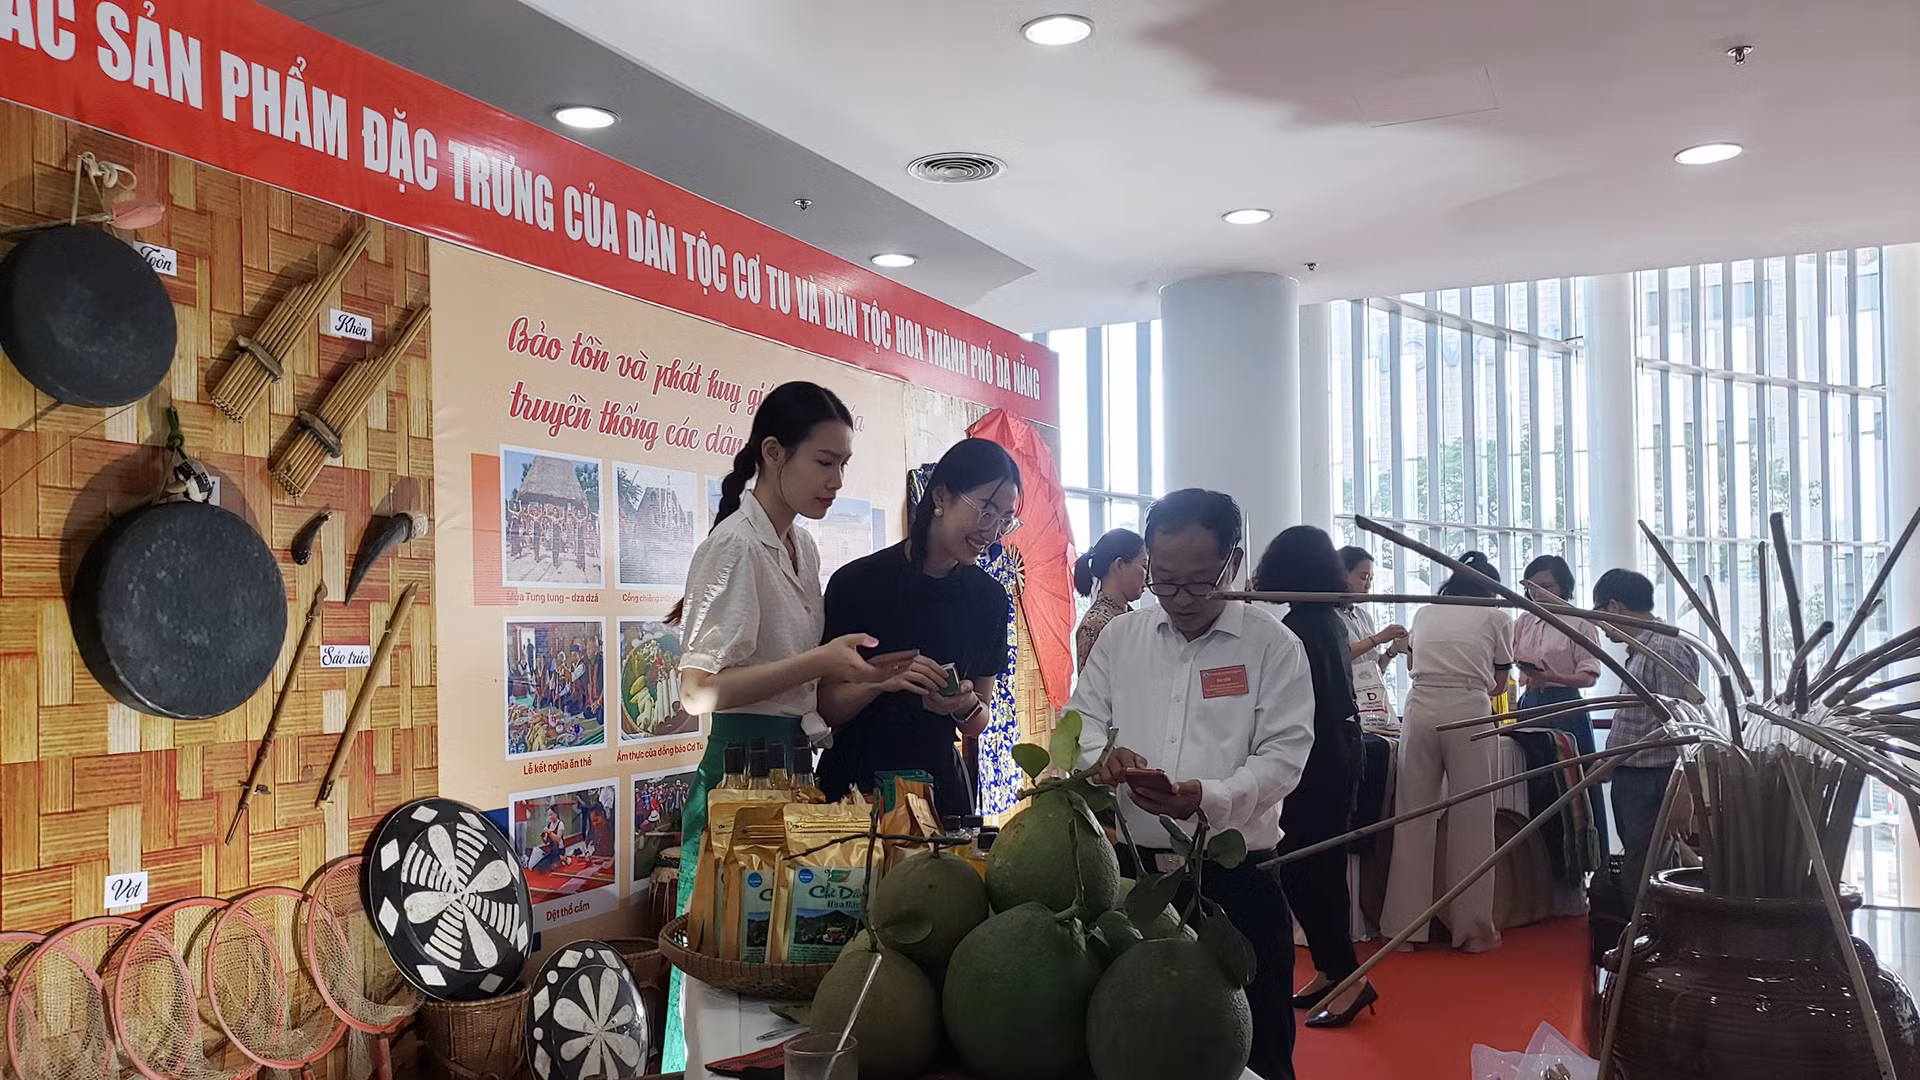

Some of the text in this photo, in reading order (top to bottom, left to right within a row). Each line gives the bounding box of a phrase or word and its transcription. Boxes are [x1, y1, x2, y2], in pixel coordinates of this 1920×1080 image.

[96, 1, 203, 110] SẢN
[220, 50, 348, 160] PHẨM
[362, 106, 438, 193] ĐẶC
[448, 139, 554, 233] TRƯNG
[564, 182, 620, 255] CỦA
[627, 209, 677, 276] DÂN
[682, 231, 727, 295] TỘC
[732, 252, 761, 305] CƠ
[766, 264, 791, 315] TU
[795, 275, 820, 325] VÀ
[824, 287, 858, 339] DÂN
[861, 301, 891, 353] TỘC
[895, 315, 924, 361] HOA
[926, 327, 967, 376] THÀNH
[970, 340, 993, 385] PHỐ
[996, 351, 1011, 391] ĐÀ
[1014, 353, 1040, 400] NẴNG
[335, 315, 368, 336] Khèn
[508, 317, 773, 416] Bảo tồn và phát huy gi
[509, 382, 744, 456] truyền thống các dân
[526, 592, 546, 604] Tung
[322, 646, 369, 666] Sáo trúc
[523, 762, 533, 775] Lễ
[534, 761, 547, 774] kết
[548, 760, 569, 773] nghĩa
[111, 879, 142, 903] Vọt
[546, 907, 560, 921] Dệt
